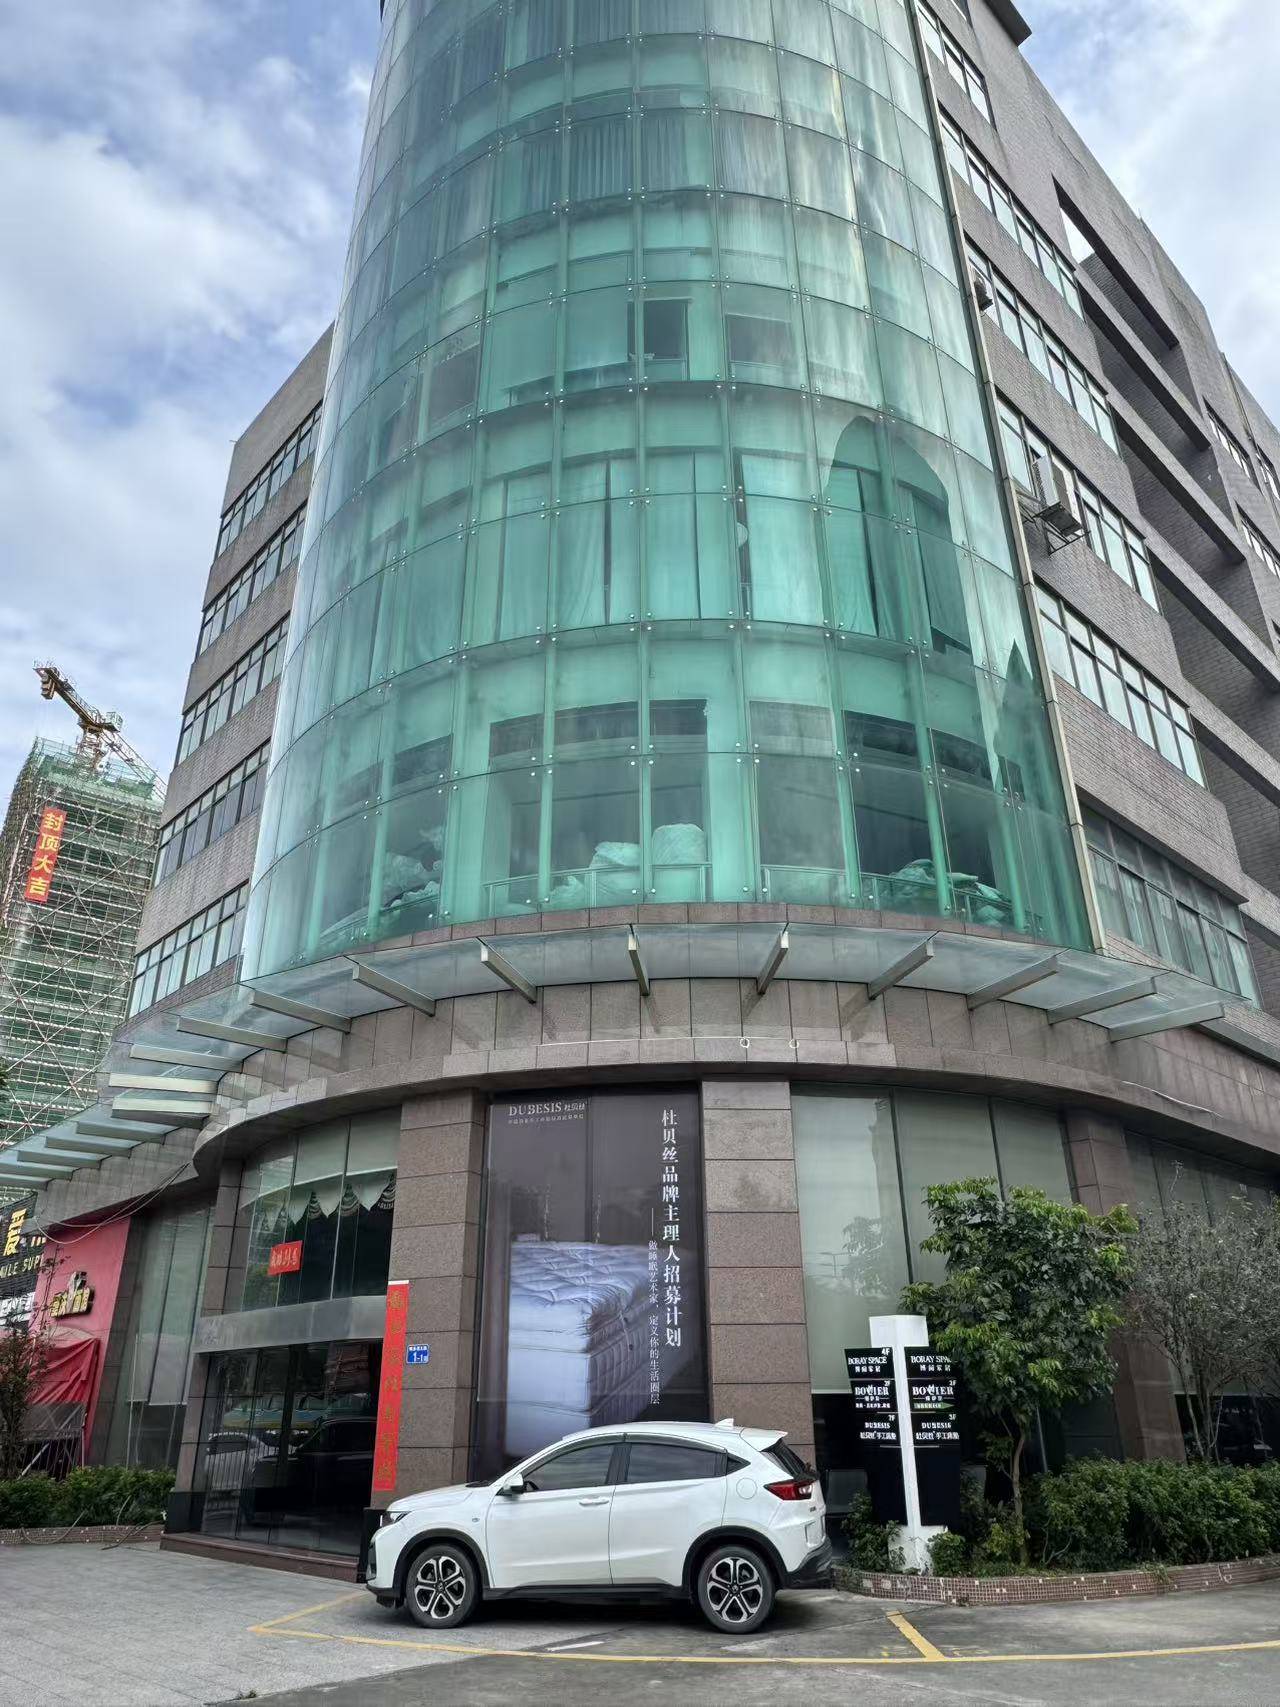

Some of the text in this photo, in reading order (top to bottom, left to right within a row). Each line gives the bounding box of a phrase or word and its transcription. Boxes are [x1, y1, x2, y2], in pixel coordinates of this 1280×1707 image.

[28, 812, 63, 896] 封顶大吉
[509, 1101, 562, 1116] DUBESIS
[661, 1109, 682, 1347] 杜贝丝品牌主理人招募计划
[910, 1355, 934, 1363] BORAY
